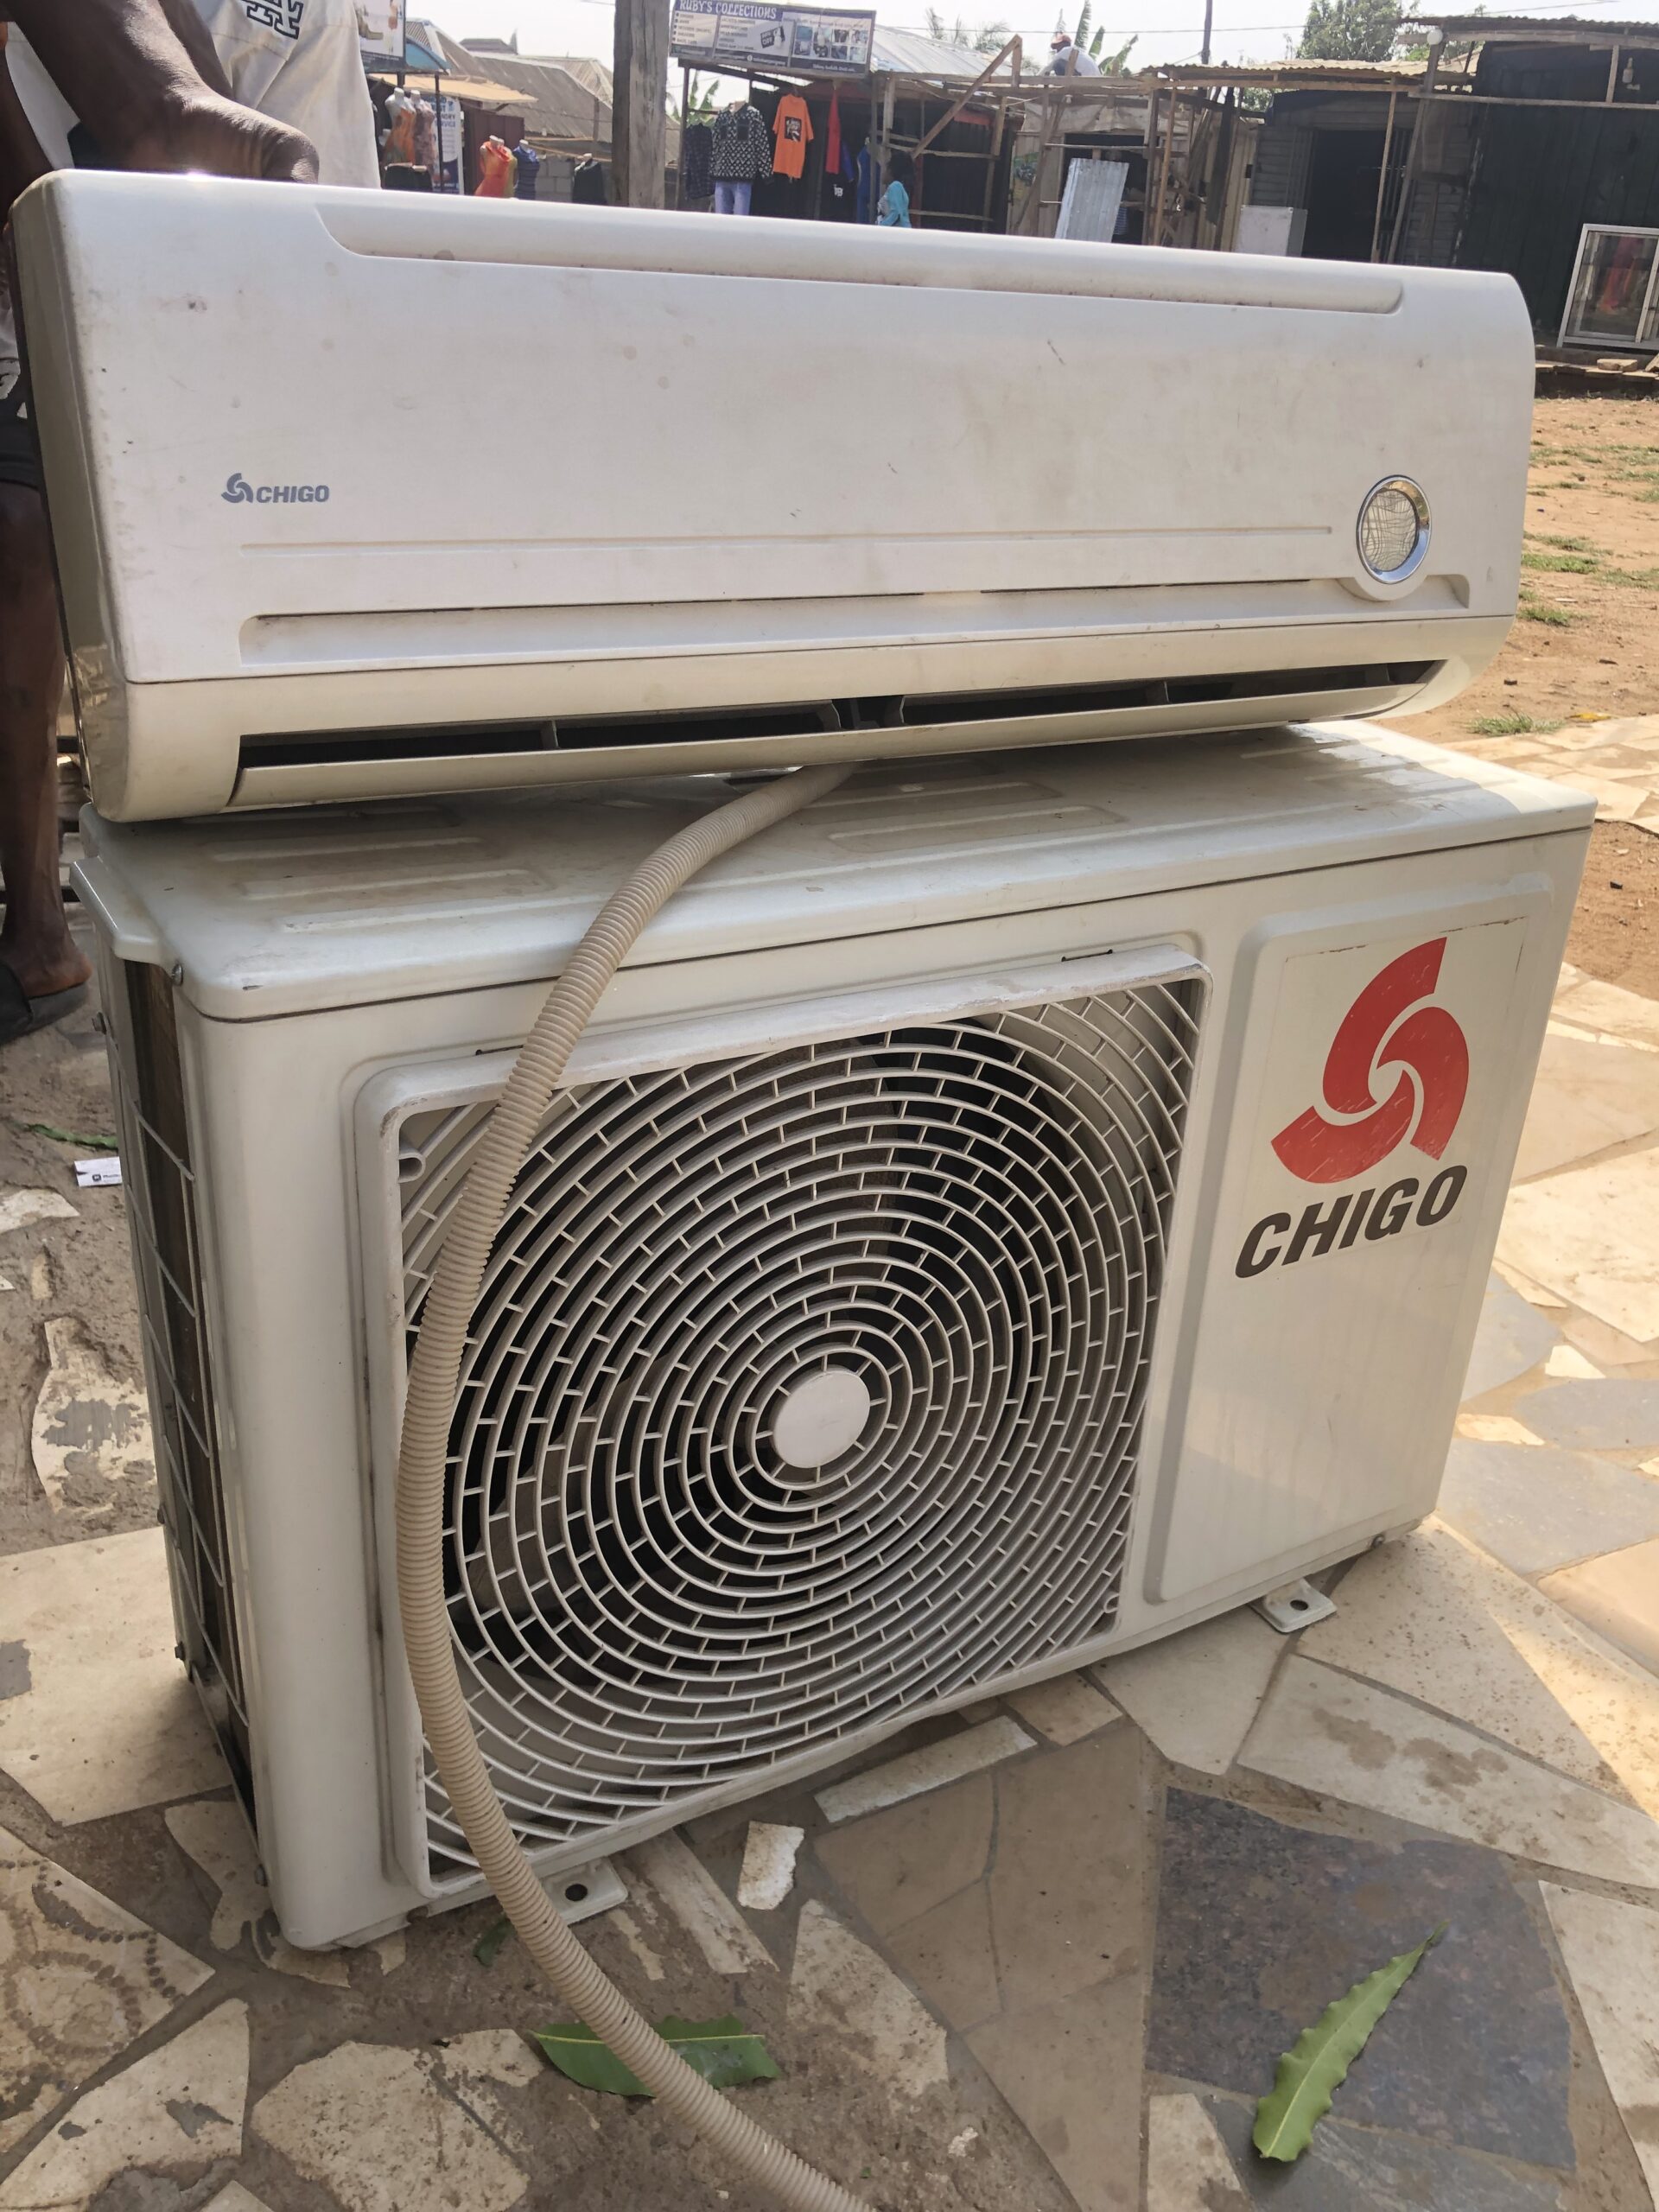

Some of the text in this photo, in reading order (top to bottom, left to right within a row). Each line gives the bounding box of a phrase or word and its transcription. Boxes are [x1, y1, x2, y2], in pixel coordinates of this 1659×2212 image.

[679, 0, 778, 19] RUBY'S COLLECTIONS
[256, 485, 330, 504] CHIGO
[1235, 1165, 1468, 1279] CHIGO
